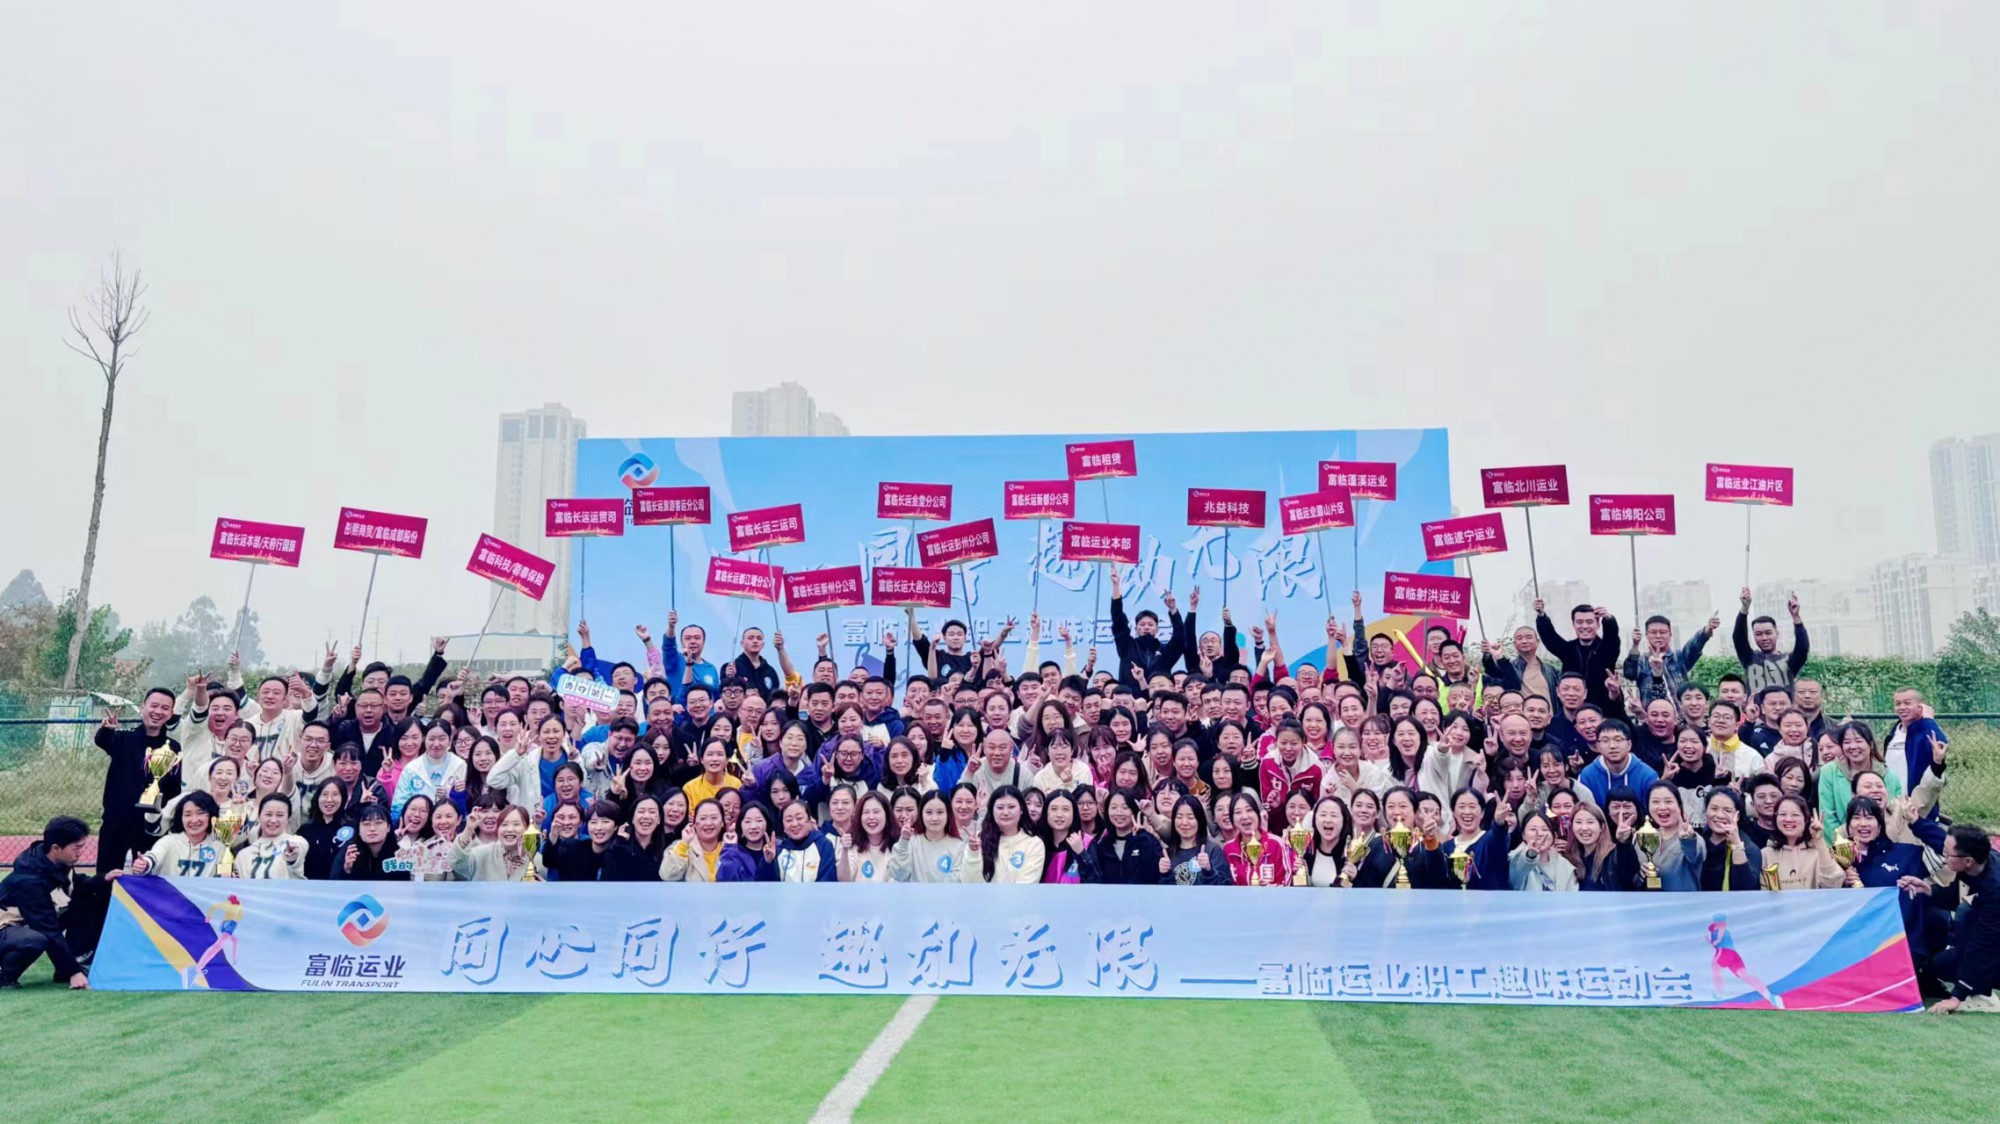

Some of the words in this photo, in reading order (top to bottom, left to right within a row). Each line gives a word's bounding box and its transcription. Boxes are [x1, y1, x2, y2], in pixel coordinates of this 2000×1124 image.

[1082, 453, 1121, 467] 富临租赁
[1328, 474, 1388, 487] 富临蓬溪运业
[1493, 479, 1558, 493] 富临北川运业
[1716, 476, 1783, 492] 富临运业江油片区
[885, 494, 946, 507] 富临长运金堂分公司
[1205, 502, 1248, 514] 兆益科技
[1289, 502, 1345, 521] 富临运业眉山片区
[1601, 508, 1665, 520] 富临绵阳公司
[735, 517, 798, 538] 富临长运三运司
[926, 532, 990, 557] 富临长运彭州分公司
[1072, 535, 1131, 550] 富临运业本部
[1433, 527, 1496, 547] 富临遂宁运业
[792, 579, 857, 599] 富临长运崇州分公司
[879, 580, 945, 594] 富临长运大邑分公司
[1395, 587, 1460, 603] 富临射洪运业
[177, 859, 205, 877] 77
[252, 856, 275, 879] 77
[442, 914, 767, 988] 同心同行
[305, 953, 406, 979] 富临运业
[300, 980, 333, 989] FULIN
[336, 980, 400, 990] TRANSPORT
